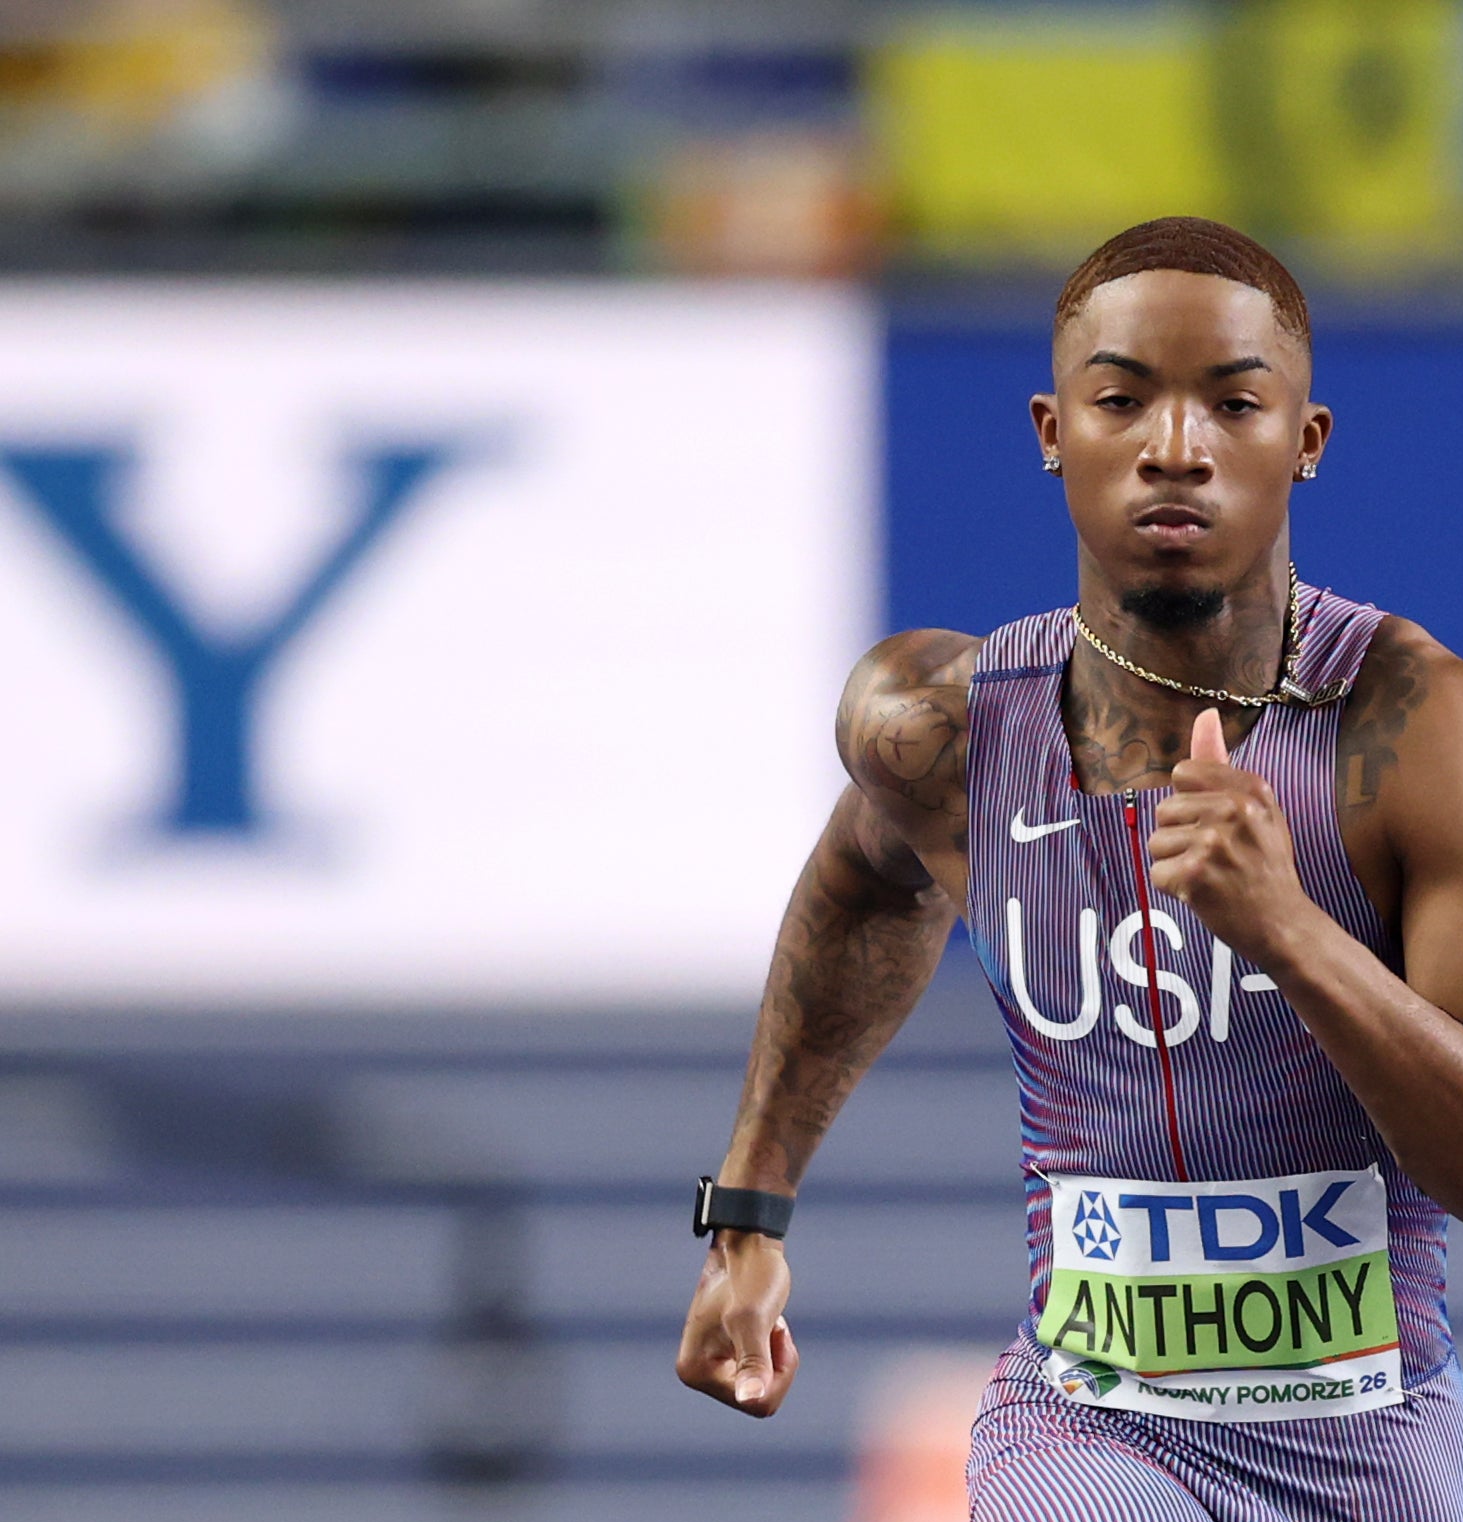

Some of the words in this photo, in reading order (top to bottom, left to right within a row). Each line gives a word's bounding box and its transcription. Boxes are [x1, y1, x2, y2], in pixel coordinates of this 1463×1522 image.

[1119, 1181, 1361, 1262] TDK
[1053, 1262, 1370, 1357] ANTHONY
[1236, 1379, 1354, 1405] POMORZE
[1359, 1371, 1387, 1394] 26
